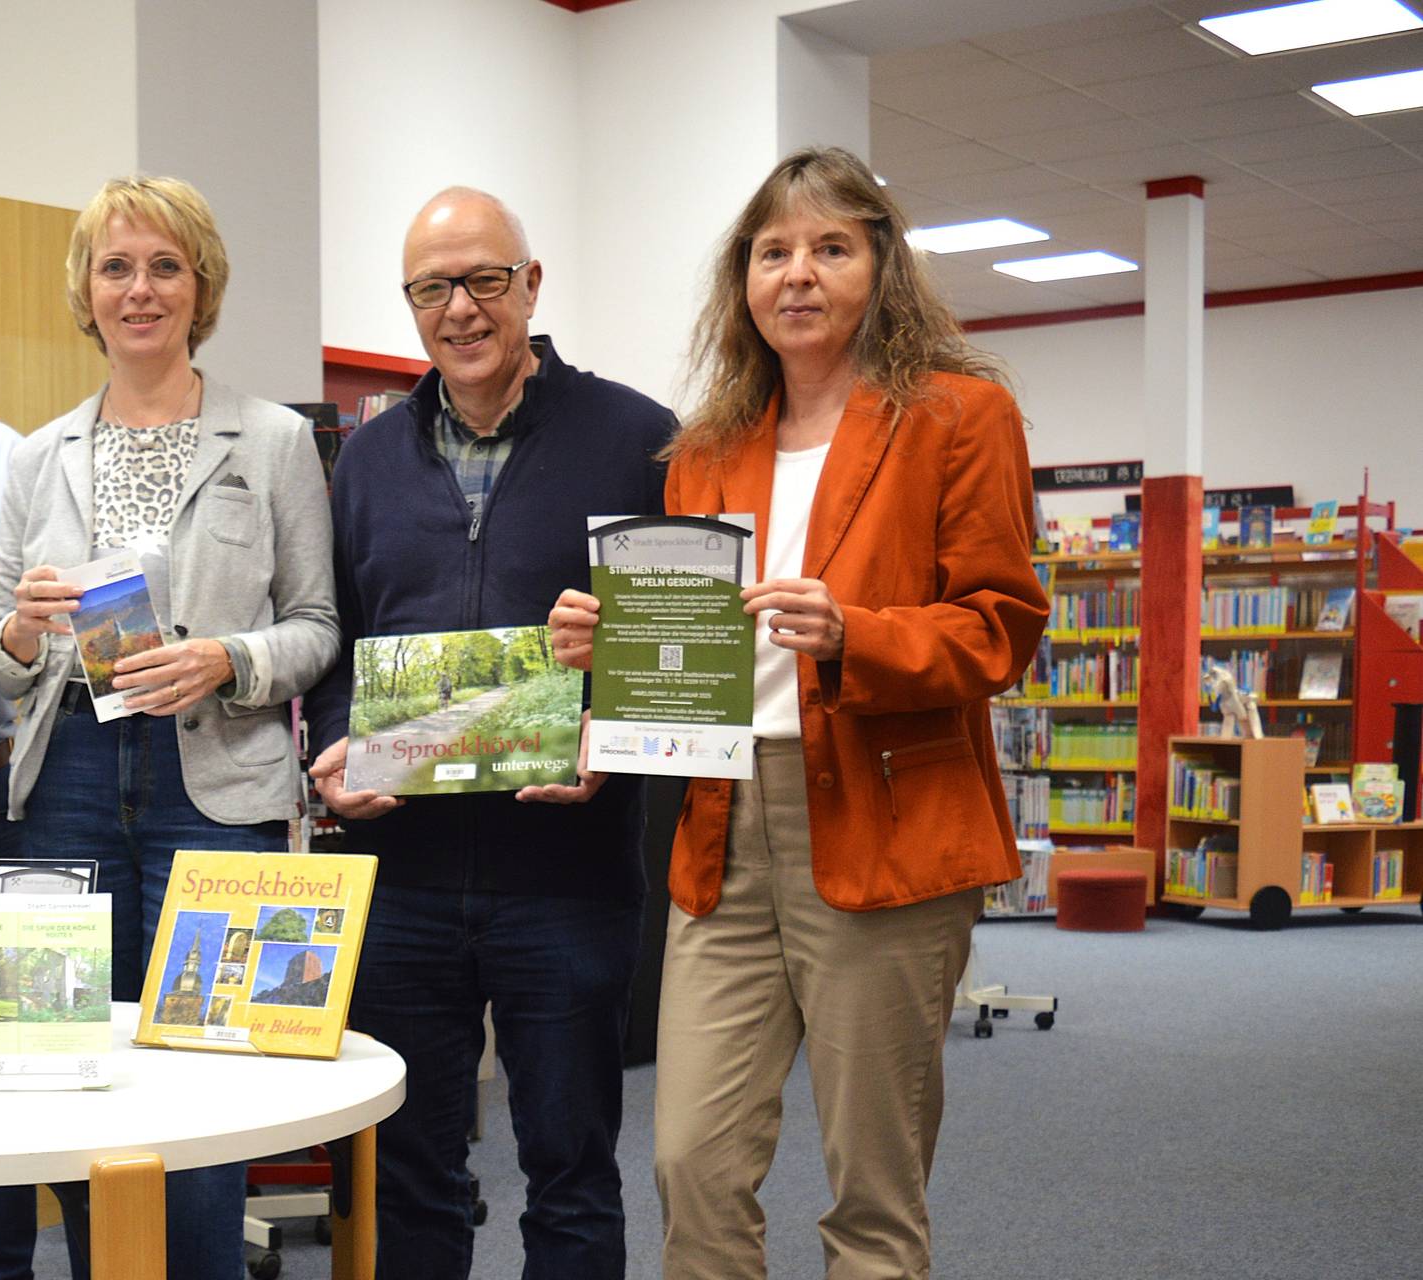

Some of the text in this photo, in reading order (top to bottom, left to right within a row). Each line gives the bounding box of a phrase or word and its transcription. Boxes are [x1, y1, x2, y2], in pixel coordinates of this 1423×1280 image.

[608, 564, 736, 574] STIMMEN FÜR SPRECHENDE
[630, 578, 714, 587] TAFELN GESUCHT!
[366, 731, 541, 766] In Sprockhövel
[492, 758, 570, 774] unterwegs
[182, 868, 343, 902] Sprockhövel
[250, 1018, 322, 1036] in Bildern
